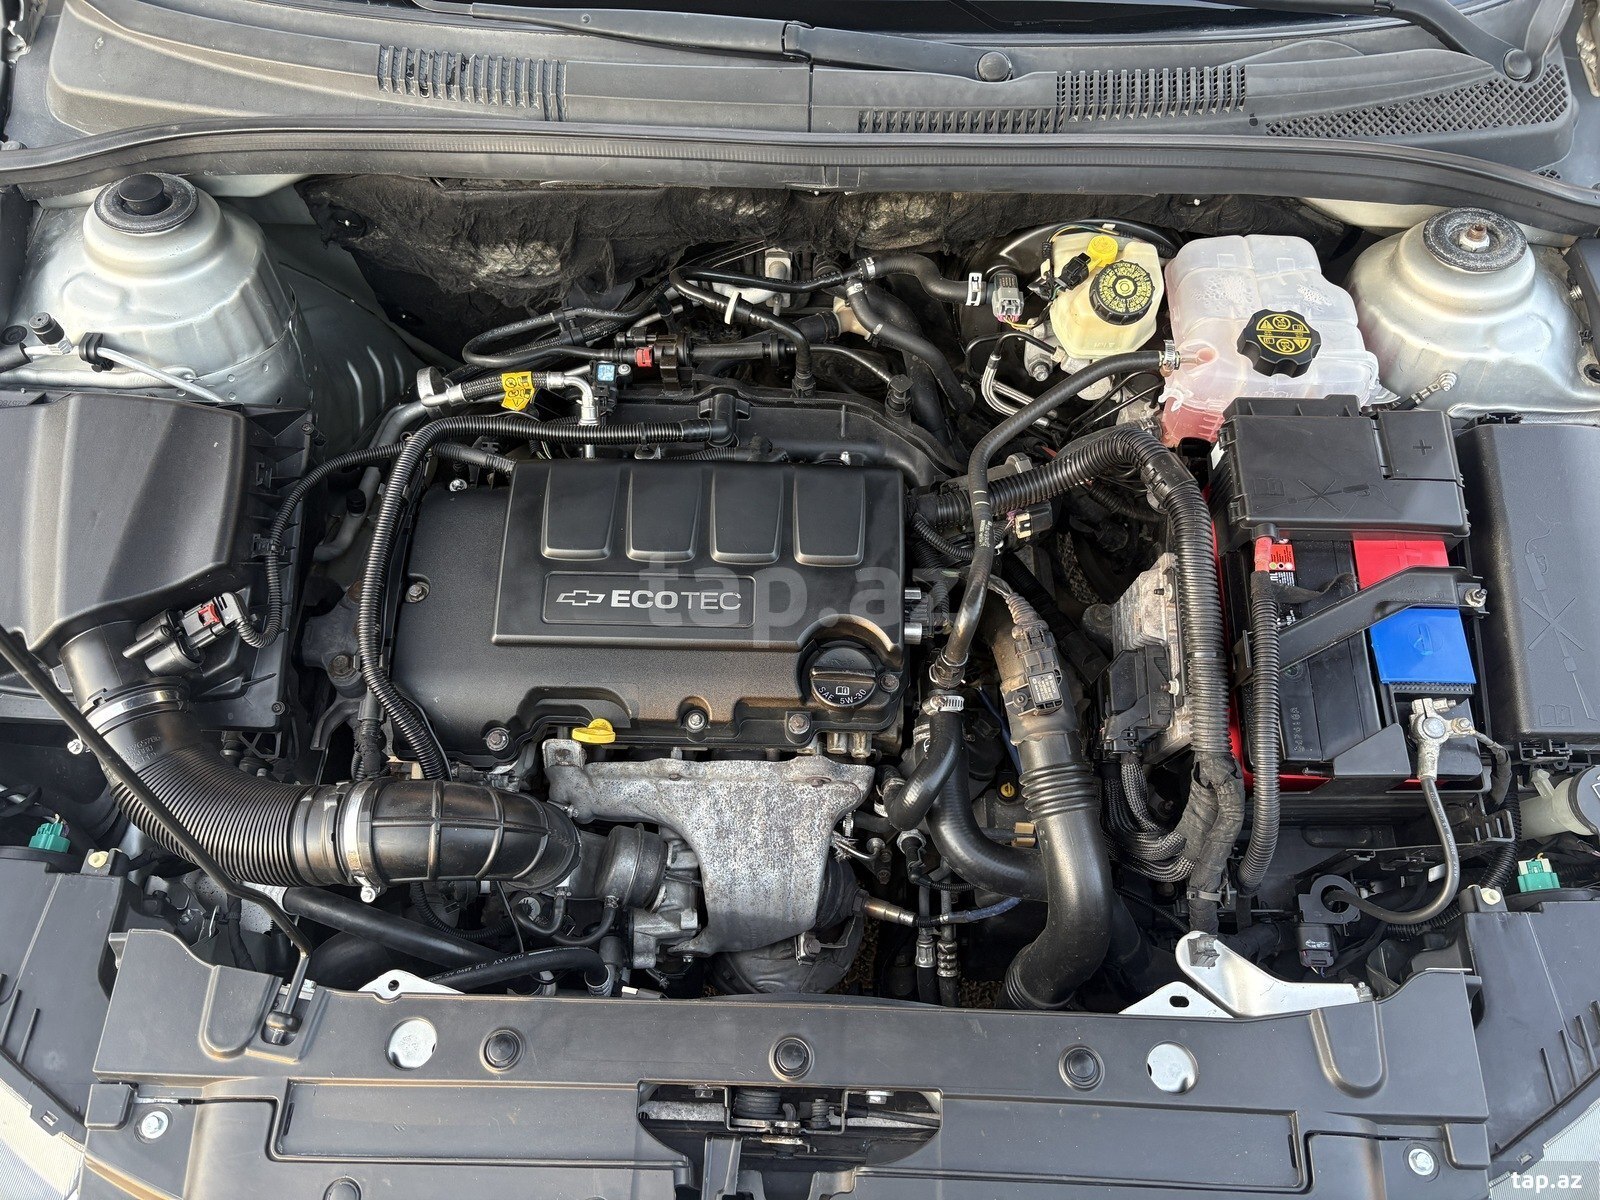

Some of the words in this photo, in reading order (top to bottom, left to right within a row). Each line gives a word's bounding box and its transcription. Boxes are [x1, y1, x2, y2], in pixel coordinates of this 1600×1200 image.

[610, 589, 742, 610] ECOTEC
[818, 686, 835, 702] SAE
[840, 688, 867, 705] 5W-30
[492, 953, 524, 965] GALAXY
